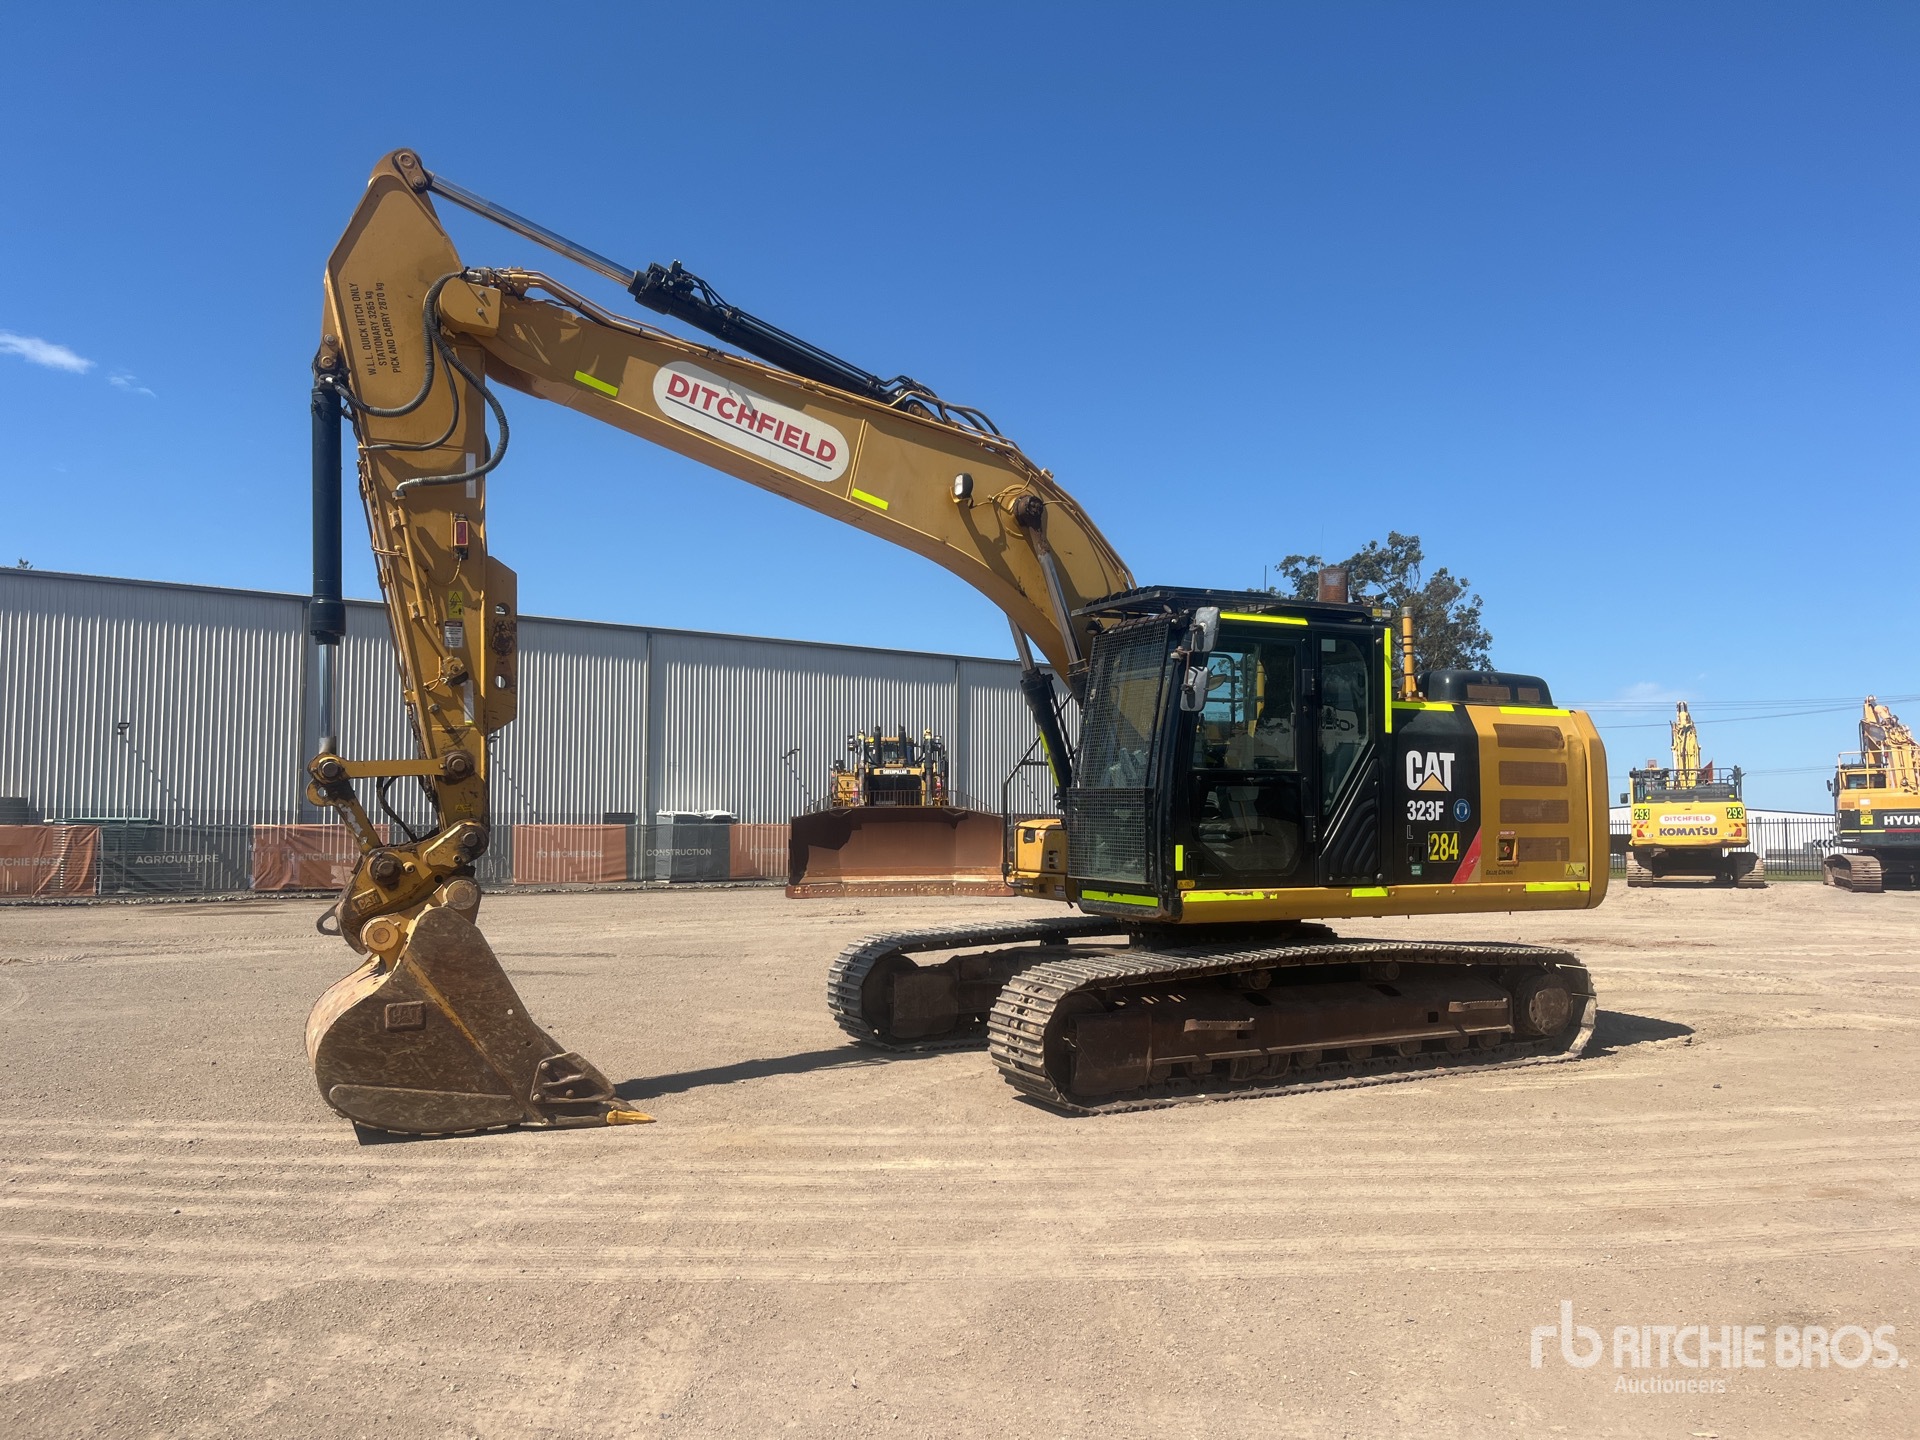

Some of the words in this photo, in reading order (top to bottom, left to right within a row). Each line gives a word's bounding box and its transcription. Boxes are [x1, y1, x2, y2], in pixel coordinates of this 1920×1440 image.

[349, 283, 361, 302] ONLY
[365, 291, 374, 299] kg
[376, 283, 384, 291] kg
[366, 301, 377, 319] 3265
[377, 293, 388, 310] 2870
[355, 304, 366, 326] HITCH
[381, 313, 393, 336] CARRY
[360, 329, 371, 350] QUICK
[370, 321, 387, 366] STATIONARY
[386, 339, 397, 354] AND
[390, 356, 402, 373] PICK
[667, 373, 837, 463] DITCHFIELD
[1406, 750, 1455, 792] CAT
[1406, 800, 1444, 821] 323F
[1634, 808, 1650, 820] 293
[1727, 807, 1744, 819] 293
[1659, 826, 1718, 836] KOMATSU
[646, 848, 712, 857] CONSTRUCTION
[1429, 832, 1459, 861] 284
[135, 854, 219, 865] AGRICULTURE
